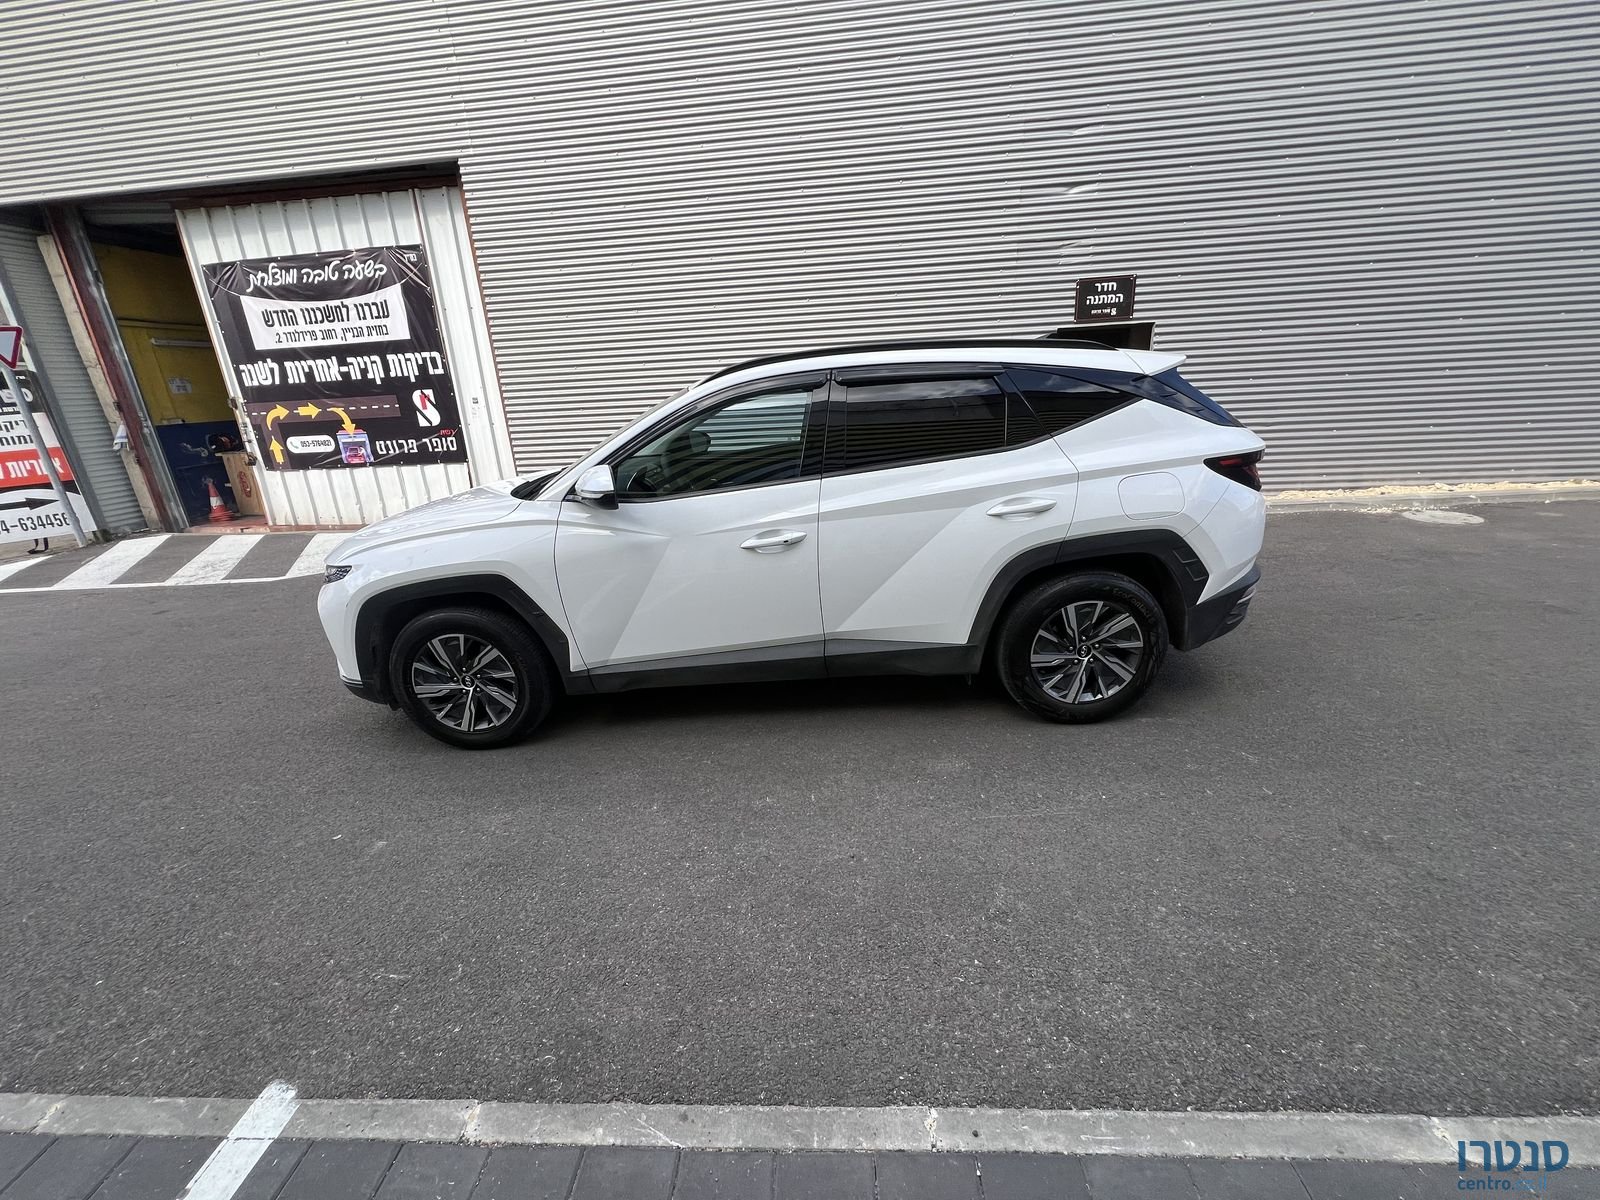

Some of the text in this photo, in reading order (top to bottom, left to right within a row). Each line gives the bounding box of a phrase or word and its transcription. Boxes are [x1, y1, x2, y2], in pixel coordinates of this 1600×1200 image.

[246, 260, 387, 292] בשעה טובה ומוצלחת
[1095, 282, 1117, 292] חדר
[1086, 293, 1124, 305] המתנה
[261, 300, 390, 328] עברנו למשכננו החדש
[320, 329, 338, 340] רחוב
[366, 324, 389, 337] בחזית
[239, 358, 280, 387] לשנה
[386, 351, 444, 382] בדיקות
[375, 436, 457, 455] סופר פרונט
[0, 512, 70, 534] 4-63445
